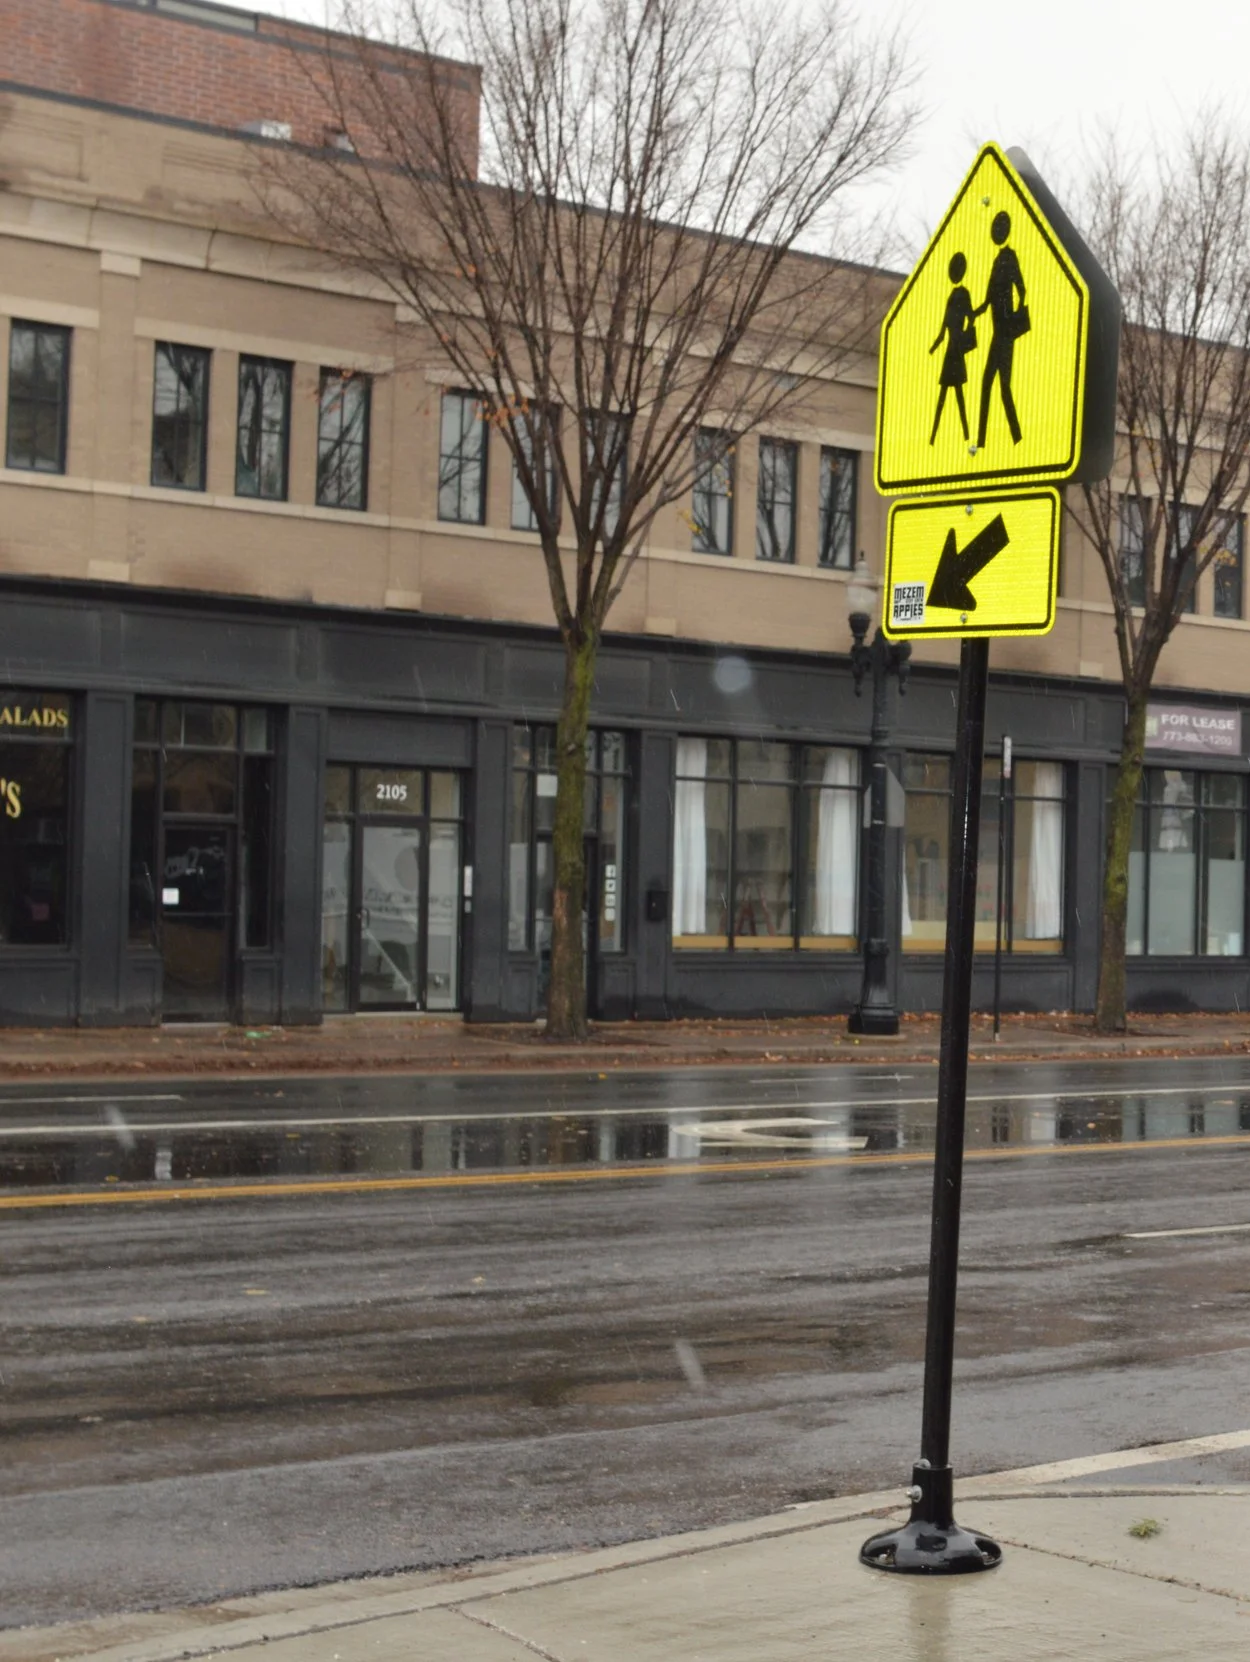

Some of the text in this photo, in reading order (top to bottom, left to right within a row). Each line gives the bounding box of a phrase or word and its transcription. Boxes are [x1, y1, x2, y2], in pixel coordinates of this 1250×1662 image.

[1160, 714, 1236, 730] FOR LEASE
[376, 784, 407, 801] 2105
